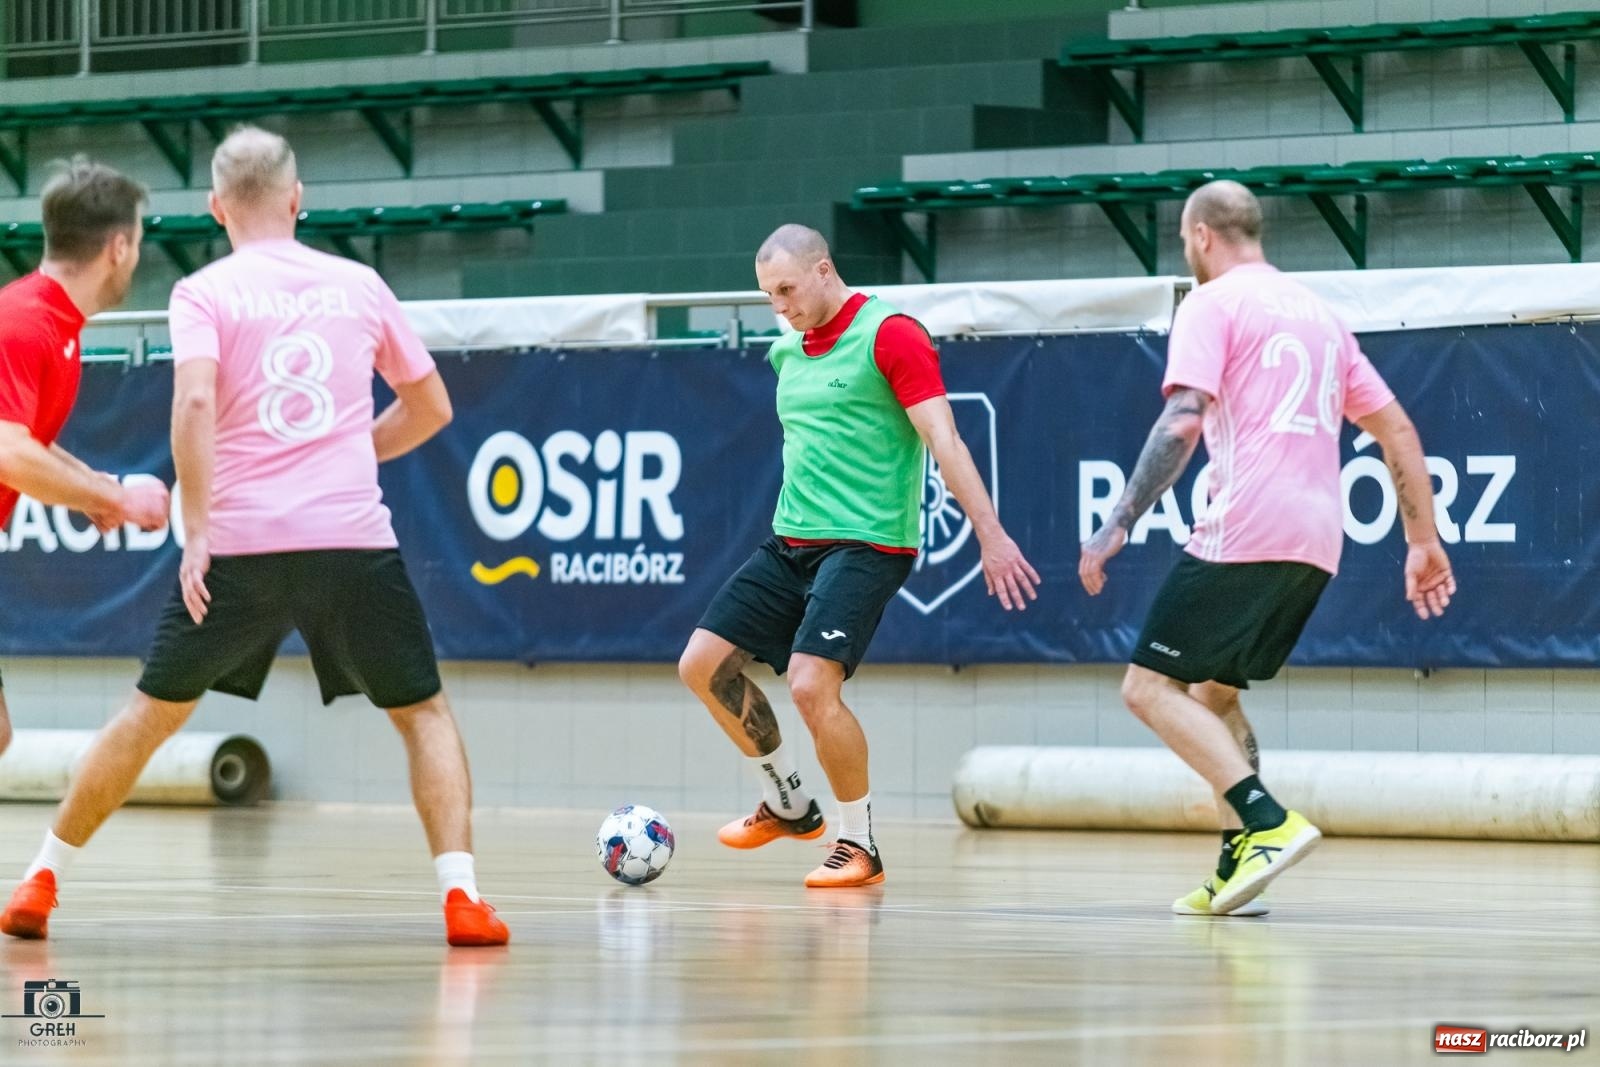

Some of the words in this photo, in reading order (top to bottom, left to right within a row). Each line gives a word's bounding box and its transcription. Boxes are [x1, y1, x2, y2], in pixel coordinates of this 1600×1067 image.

[227, 285, 360, 321] MARCEL
[257, 330, 335, 443] 8
[1078, 430, 1517, 545] RAÓRZ
[550, 543, 686, 584] RACIBÓRZ
